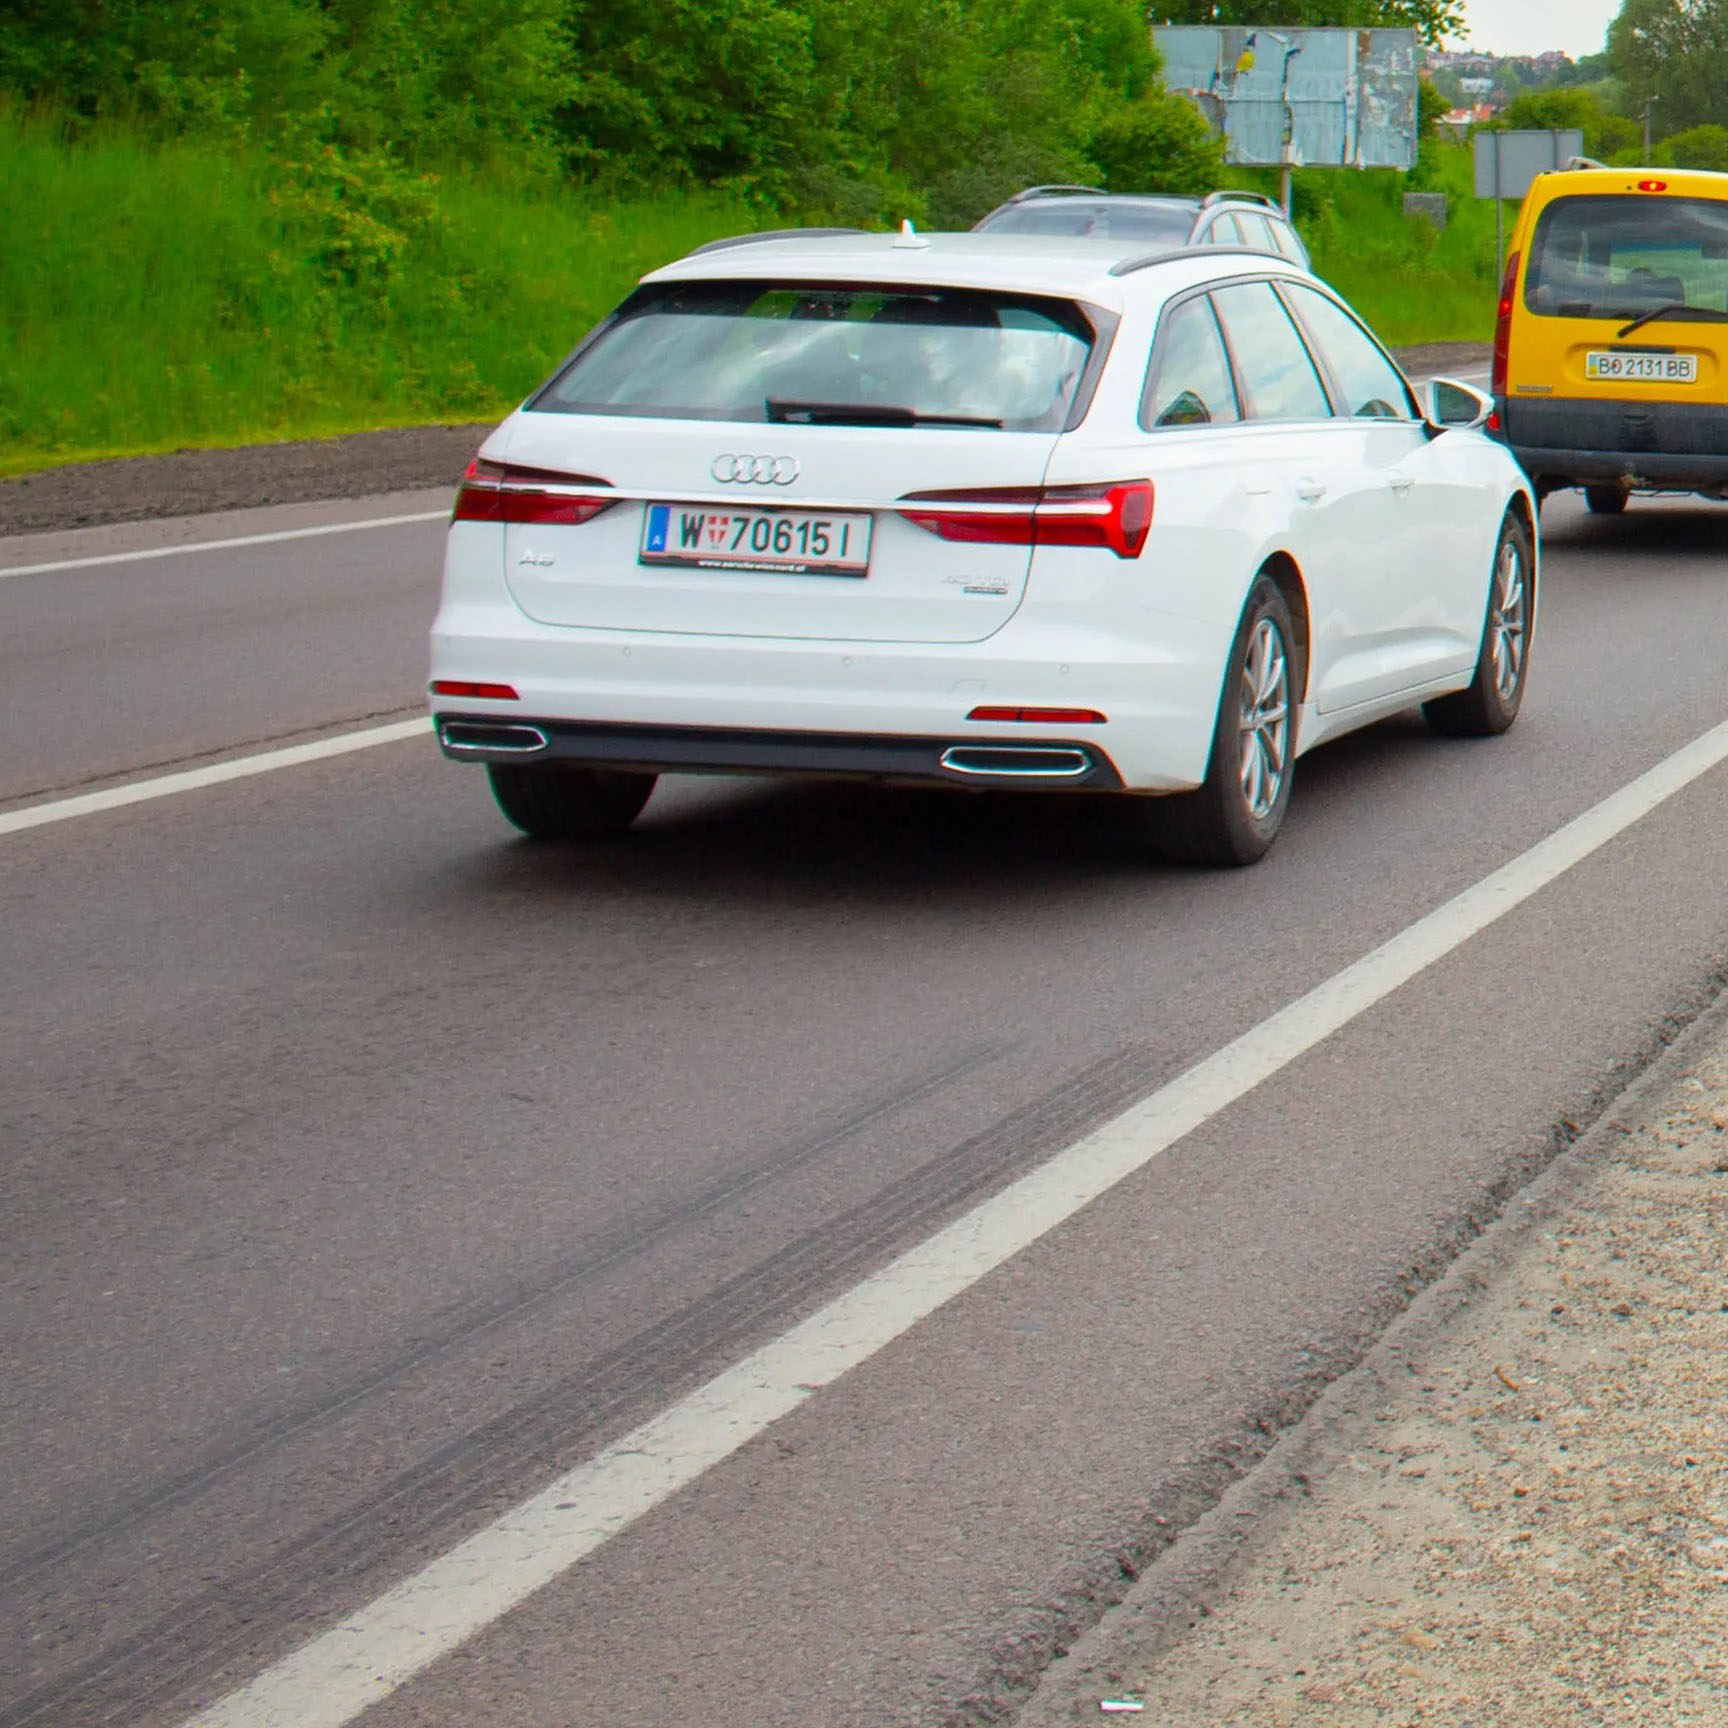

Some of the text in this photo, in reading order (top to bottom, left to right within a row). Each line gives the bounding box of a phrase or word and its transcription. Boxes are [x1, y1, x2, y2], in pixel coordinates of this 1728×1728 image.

[1625, 359, 1663, 376] 2131
[680, 513, 705, 549] W
[730, 517, 832, 557] 70615
